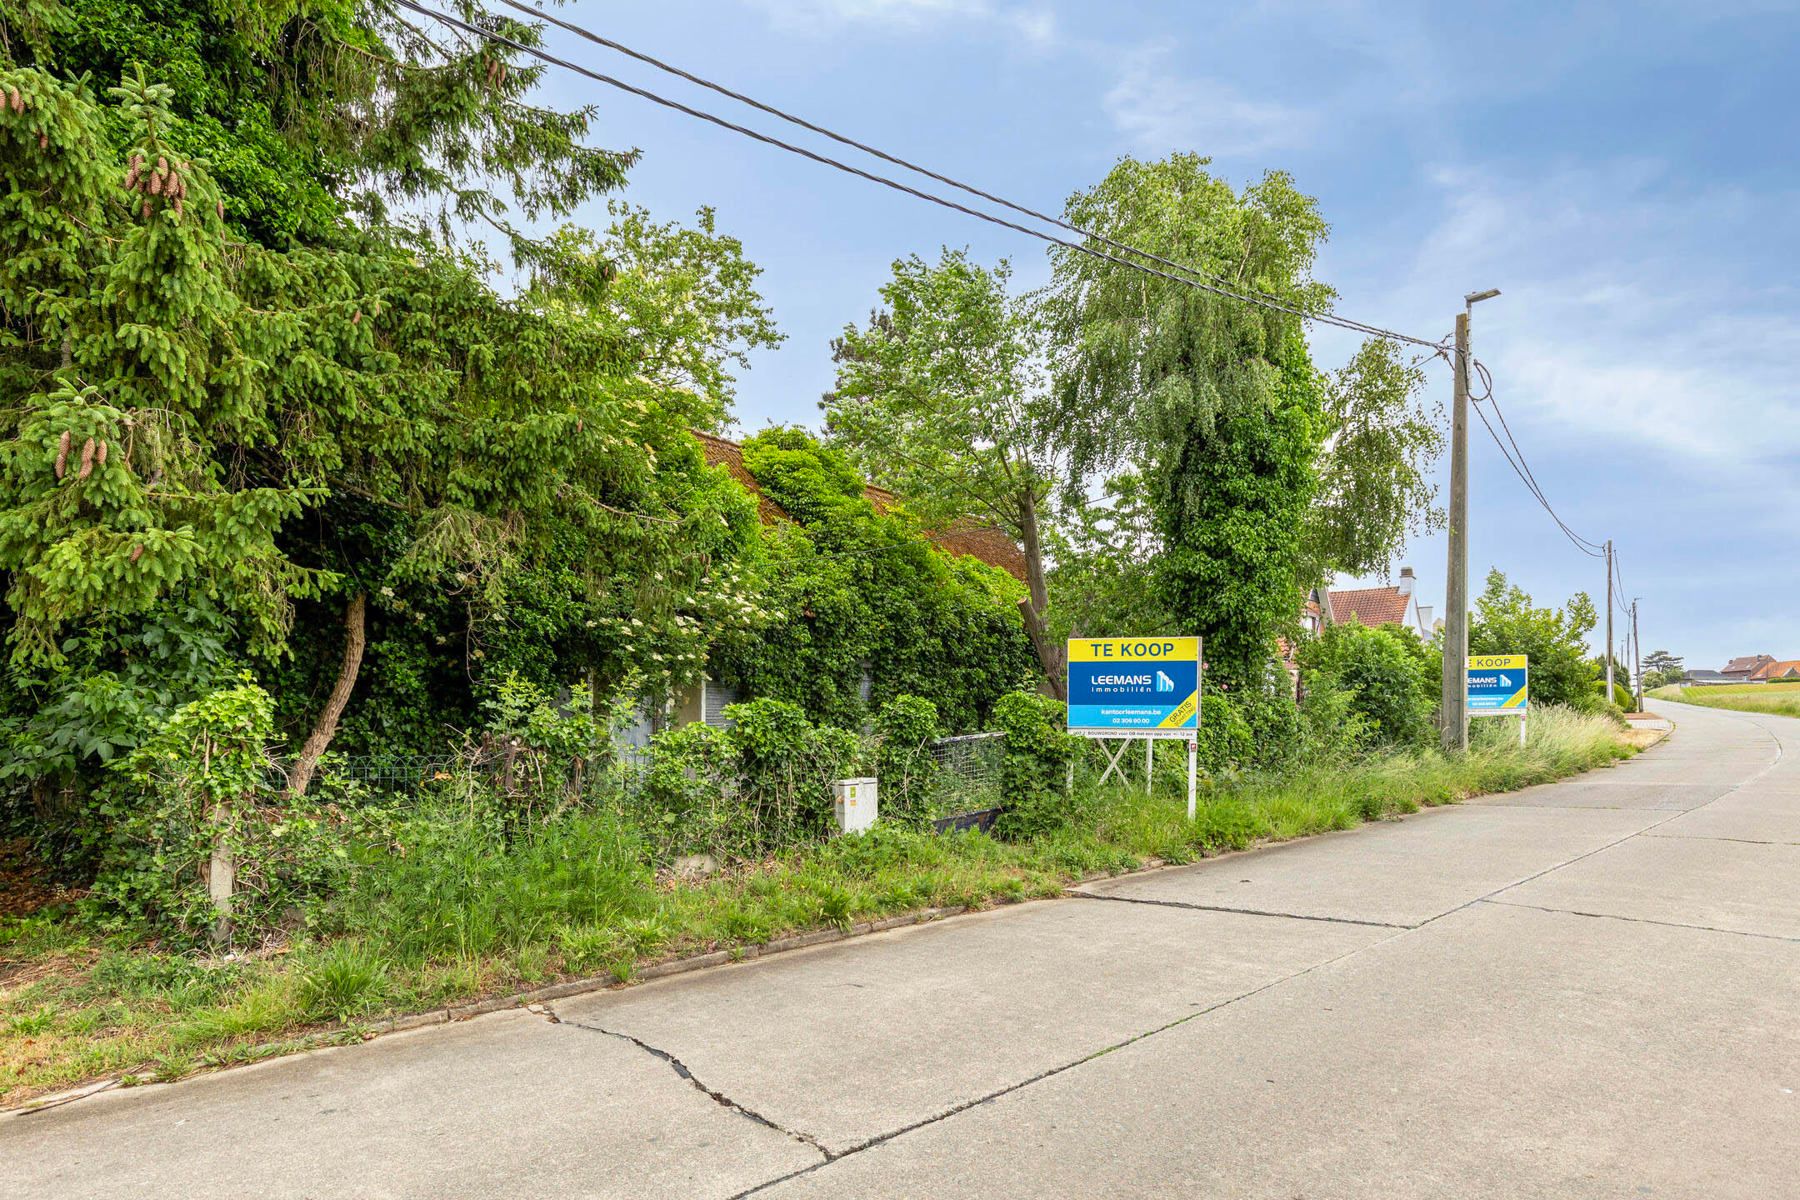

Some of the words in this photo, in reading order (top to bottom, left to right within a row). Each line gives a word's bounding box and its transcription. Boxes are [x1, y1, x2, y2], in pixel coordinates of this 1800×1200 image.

[1090, 643, 1113, 657] TE
[1121, 643, 1174, 657] KOOP
[1476, 658, 1511, 667] KOOP
[1091, 675, 1152, 685] LEEMANS
[1170, 701, 1192, 723] GRATIS
